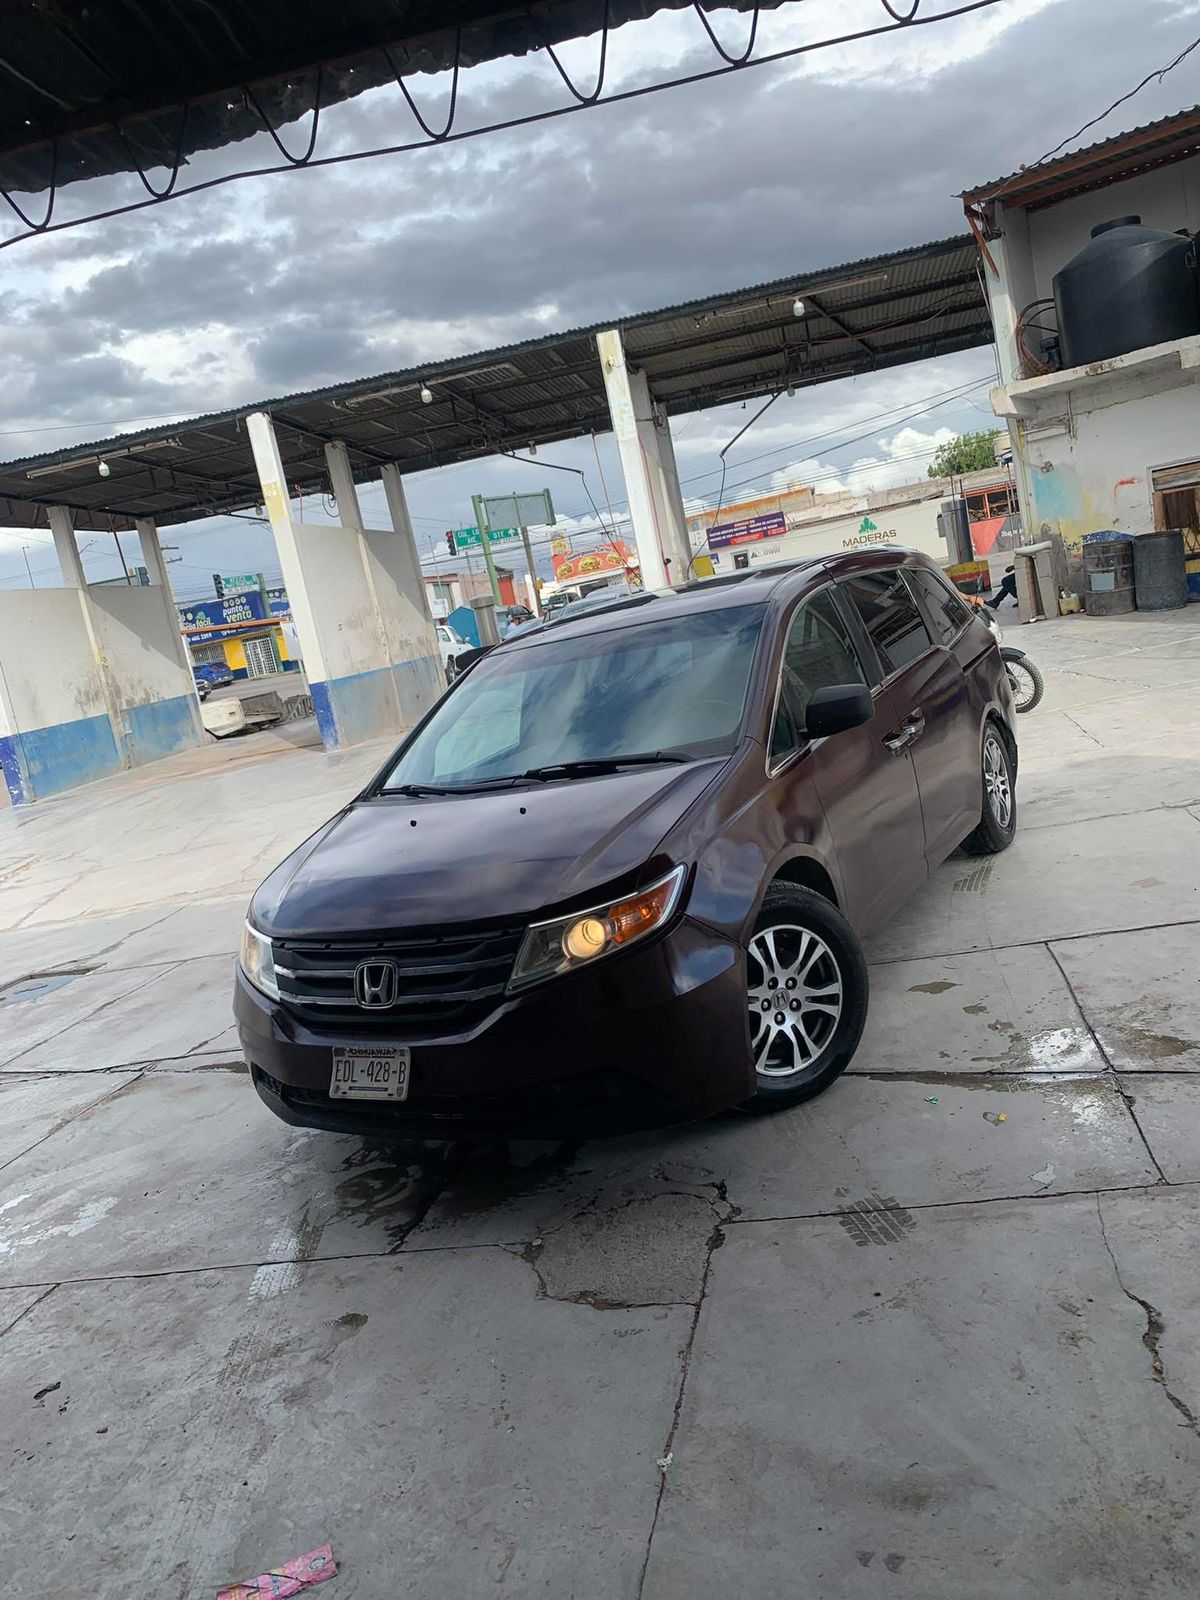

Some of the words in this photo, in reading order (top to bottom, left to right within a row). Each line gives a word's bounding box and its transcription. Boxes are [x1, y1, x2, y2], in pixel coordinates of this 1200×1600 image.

[842, 529, 897, 548] MADERAS
[222, 605, 243, 618] punto
[226, 610, 253, 623] venta
[350, 1048, 393, 1056] CHIHUAHUA
[334, 1060, 407, 1085] EDL-428-B
